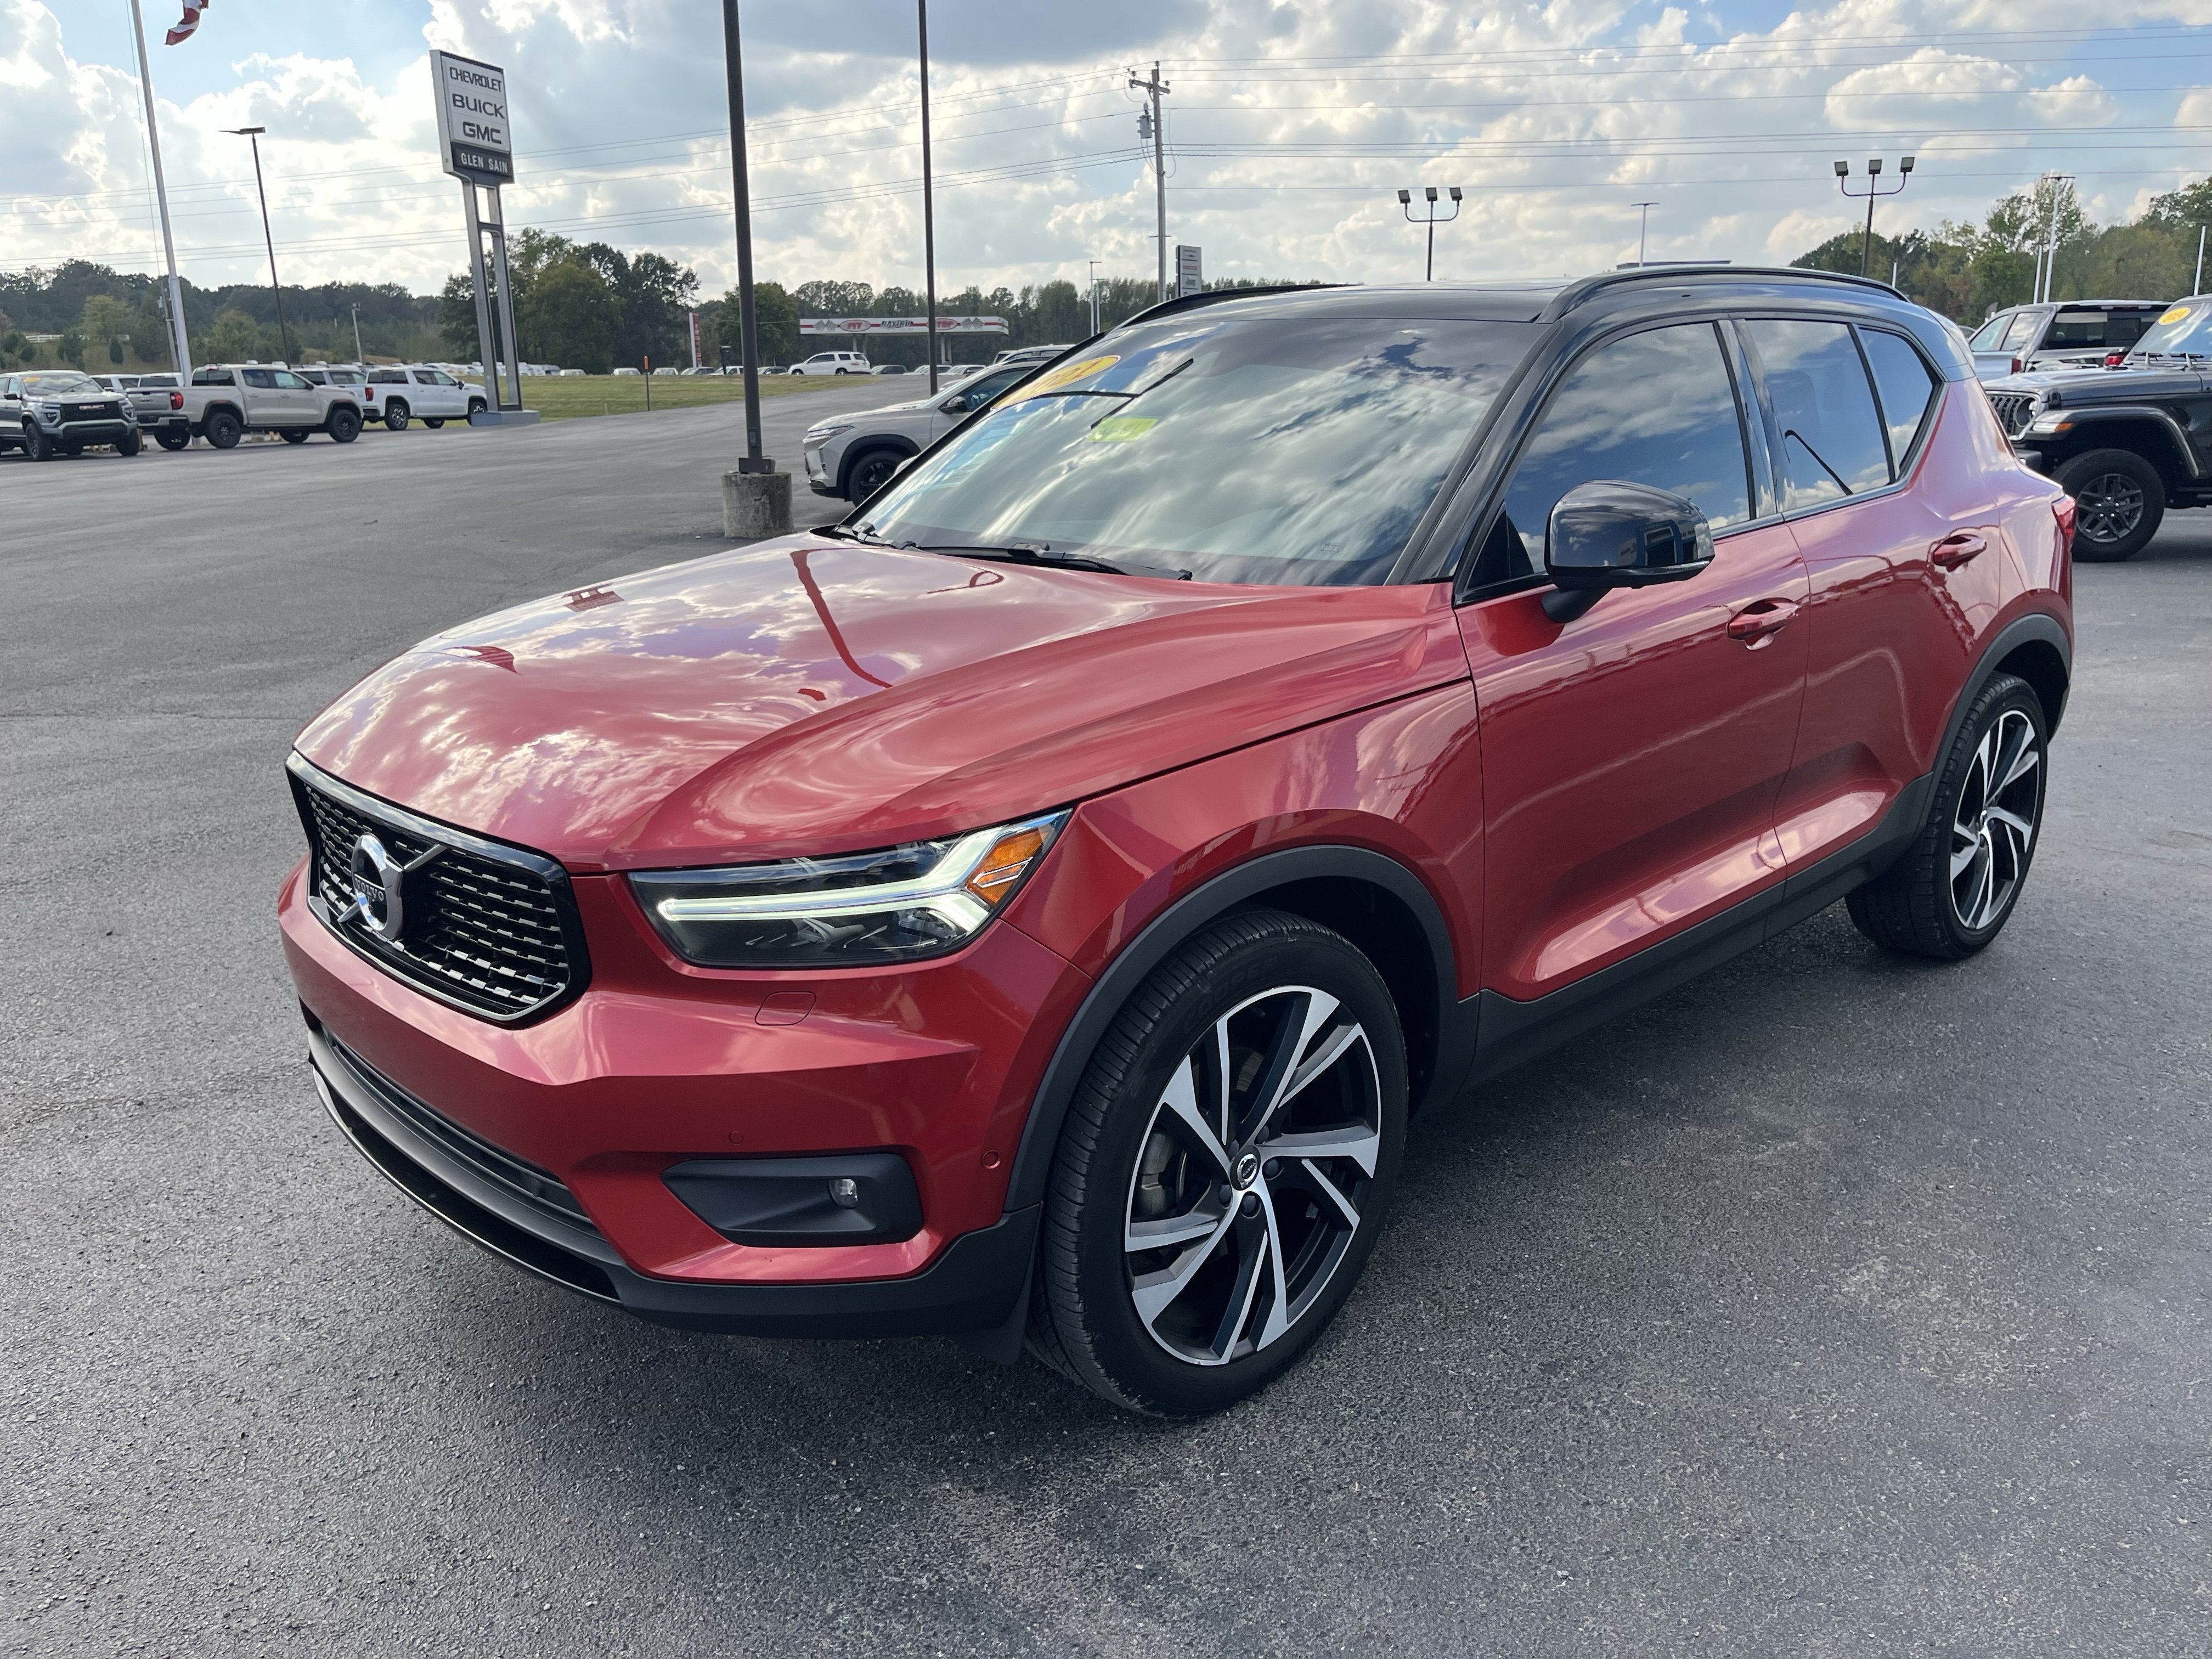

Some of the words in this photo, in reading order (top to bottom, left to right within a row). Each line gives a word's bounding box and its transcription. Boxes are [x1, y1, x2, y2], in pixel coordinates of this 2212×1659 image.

[449, 66, 501, 92] CHEVROLET
[452, 93, 506, 119] BUICK
[462, 121, 501, 144] GMC
[461, 152, 484, 168] GLEN
[488, 155, 507, 173] SAIN
[355, 878, 384, 901] VOLVO
